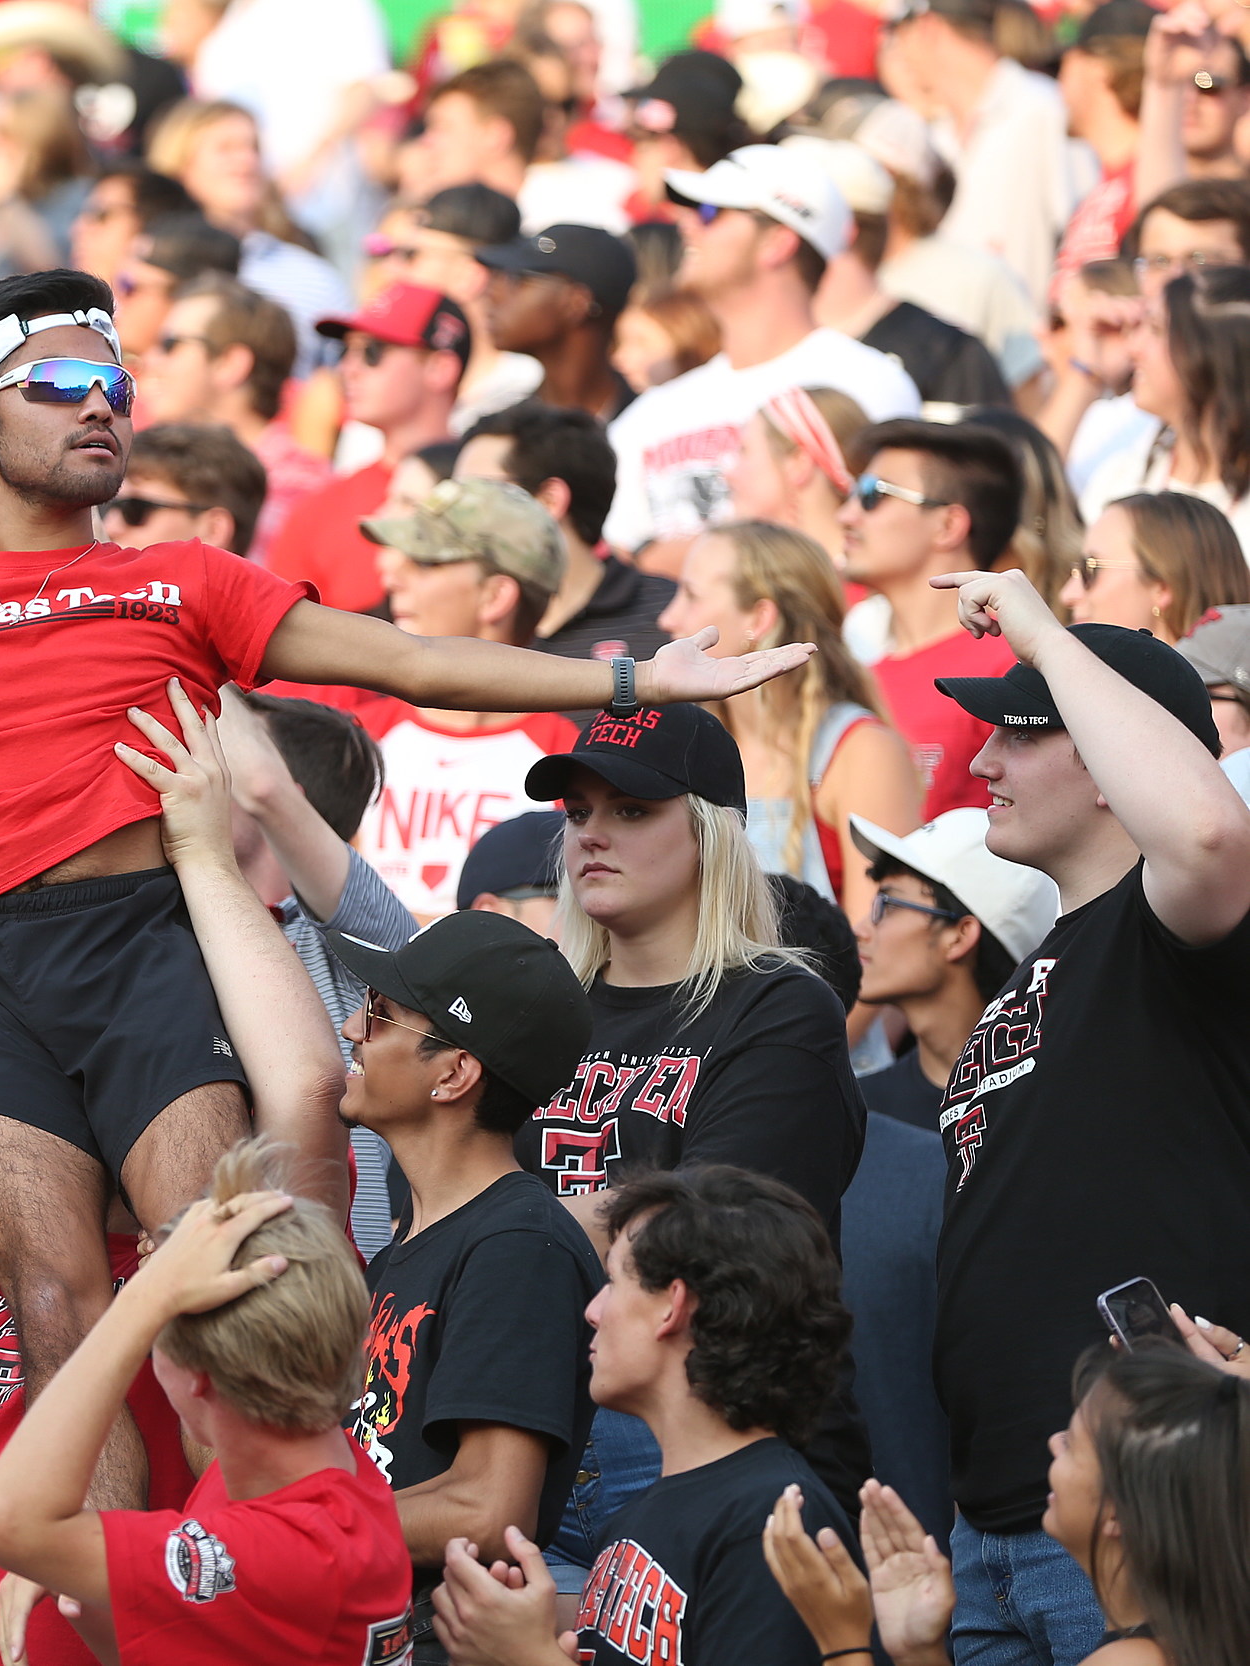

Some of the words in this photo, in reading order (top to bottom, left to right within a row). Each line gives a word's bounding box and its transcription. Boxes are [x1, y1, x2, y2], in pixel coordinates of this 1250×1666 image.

[118, 601, 180, 625] 1923
[591, 708, 663, 729] TAS
[1003, 714, 1028, 725] TEXAS
[1029, 716, 1049, 725] TECH
[586, 723, 643, 748] TECH
[378, 786, 514, 851] NIKE
[940, 1107, 959, 1127] ONES
